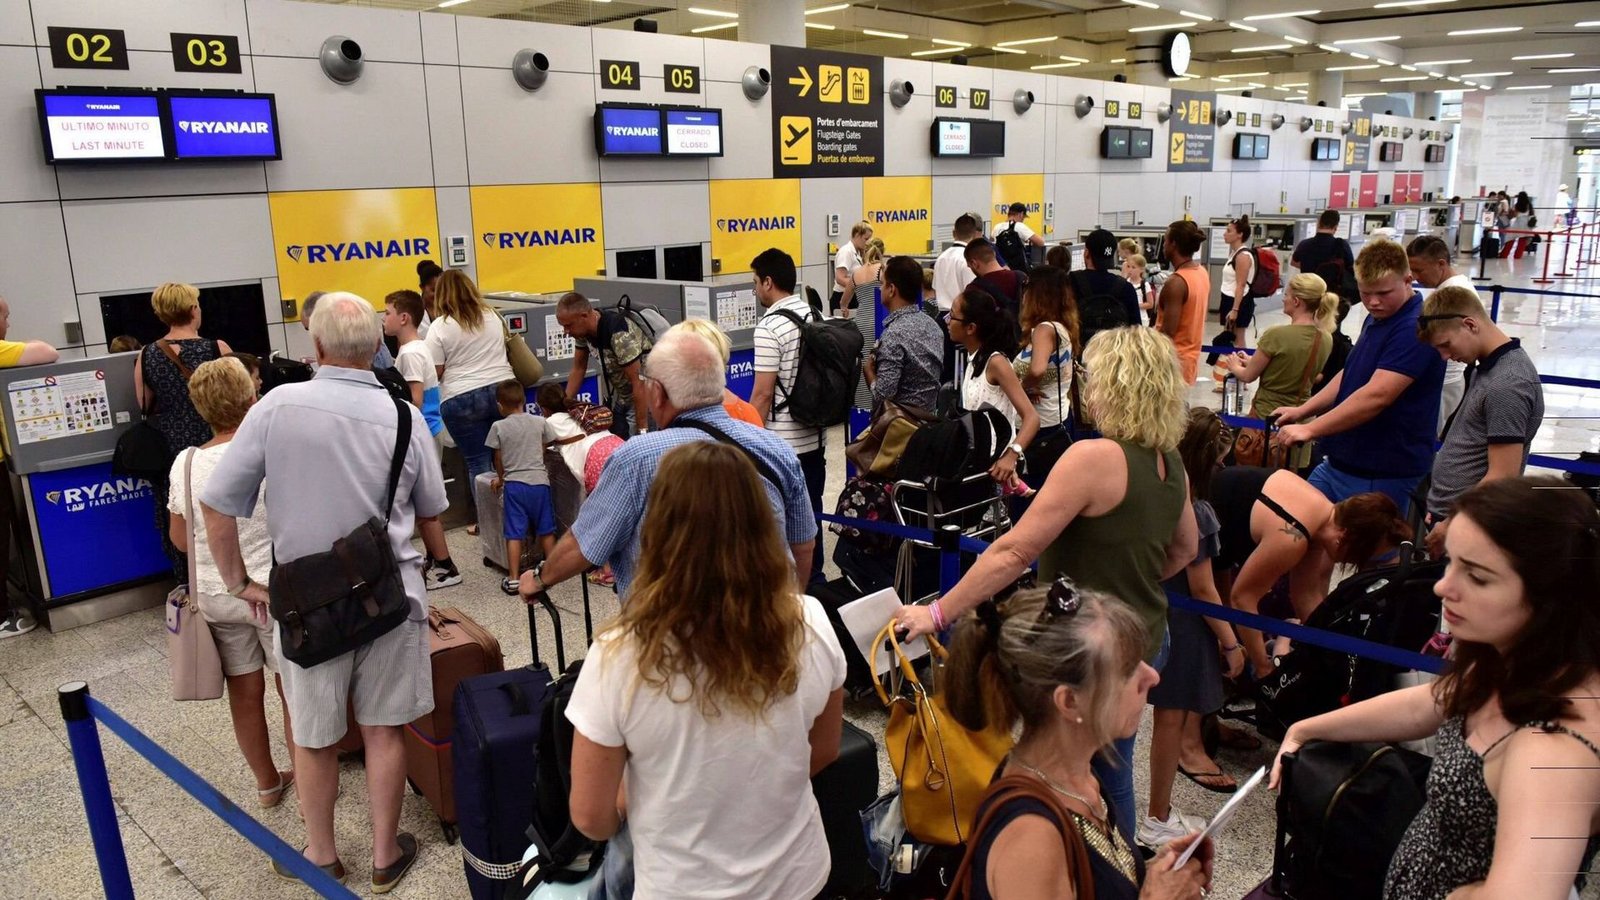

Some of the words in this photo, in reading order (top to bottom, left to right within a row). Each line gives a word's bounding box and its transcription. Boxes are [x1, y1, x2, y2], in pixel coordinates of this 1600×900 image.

[66, 33, 113, 62] 02
[187, 39, 227, 66] 03
[608, 64, 633, 85] 04
[671, 68, 694, 88] 05
[939, 88, 953, 104] 06
[973, 91, 987, 106] 07
[1107, 102, 1117, 115] 08
[1130, 104, 1140, 117] 09
[61, 122, 104, 131] ULTIMO
[107, 122, 149, 131] MINUTO
[191, 121, 269, 134] RYANAIR
[816, 117, 835, 127] Portes
[836, 118, 878, 128] d'embarcament
[613, 126, 659, 137] RYANAIR
[676, 128, 711, 136] CERRADO
[817, 130, 845, 140] Flugsteige
[845, 130, 862, 139] Gates
[72, 141, 100, 151] LAST
[104, 141, 145, 150] MINUTE
[680, 141, 709, 149] CLOSED
[817, 142, 842, 152] Boarding
[843, 143, 858, 152] gates
[817, 154, 840, 163] Puertas
[840, 154, 847, 163] de
[848, 155, 875, 165] embarque
[1001, 202, 1040, 215] RAIR
[875, 208, 928, 224] RYANAIR
[727, 215, 796, 233] RYANAIR
[498, 227, 596, 249] RYANAIR
[307, 237, 431, 264] RYANAIR
[63, 478, 153, 504] RYANA
[121, 491, 145, 500] MADE
